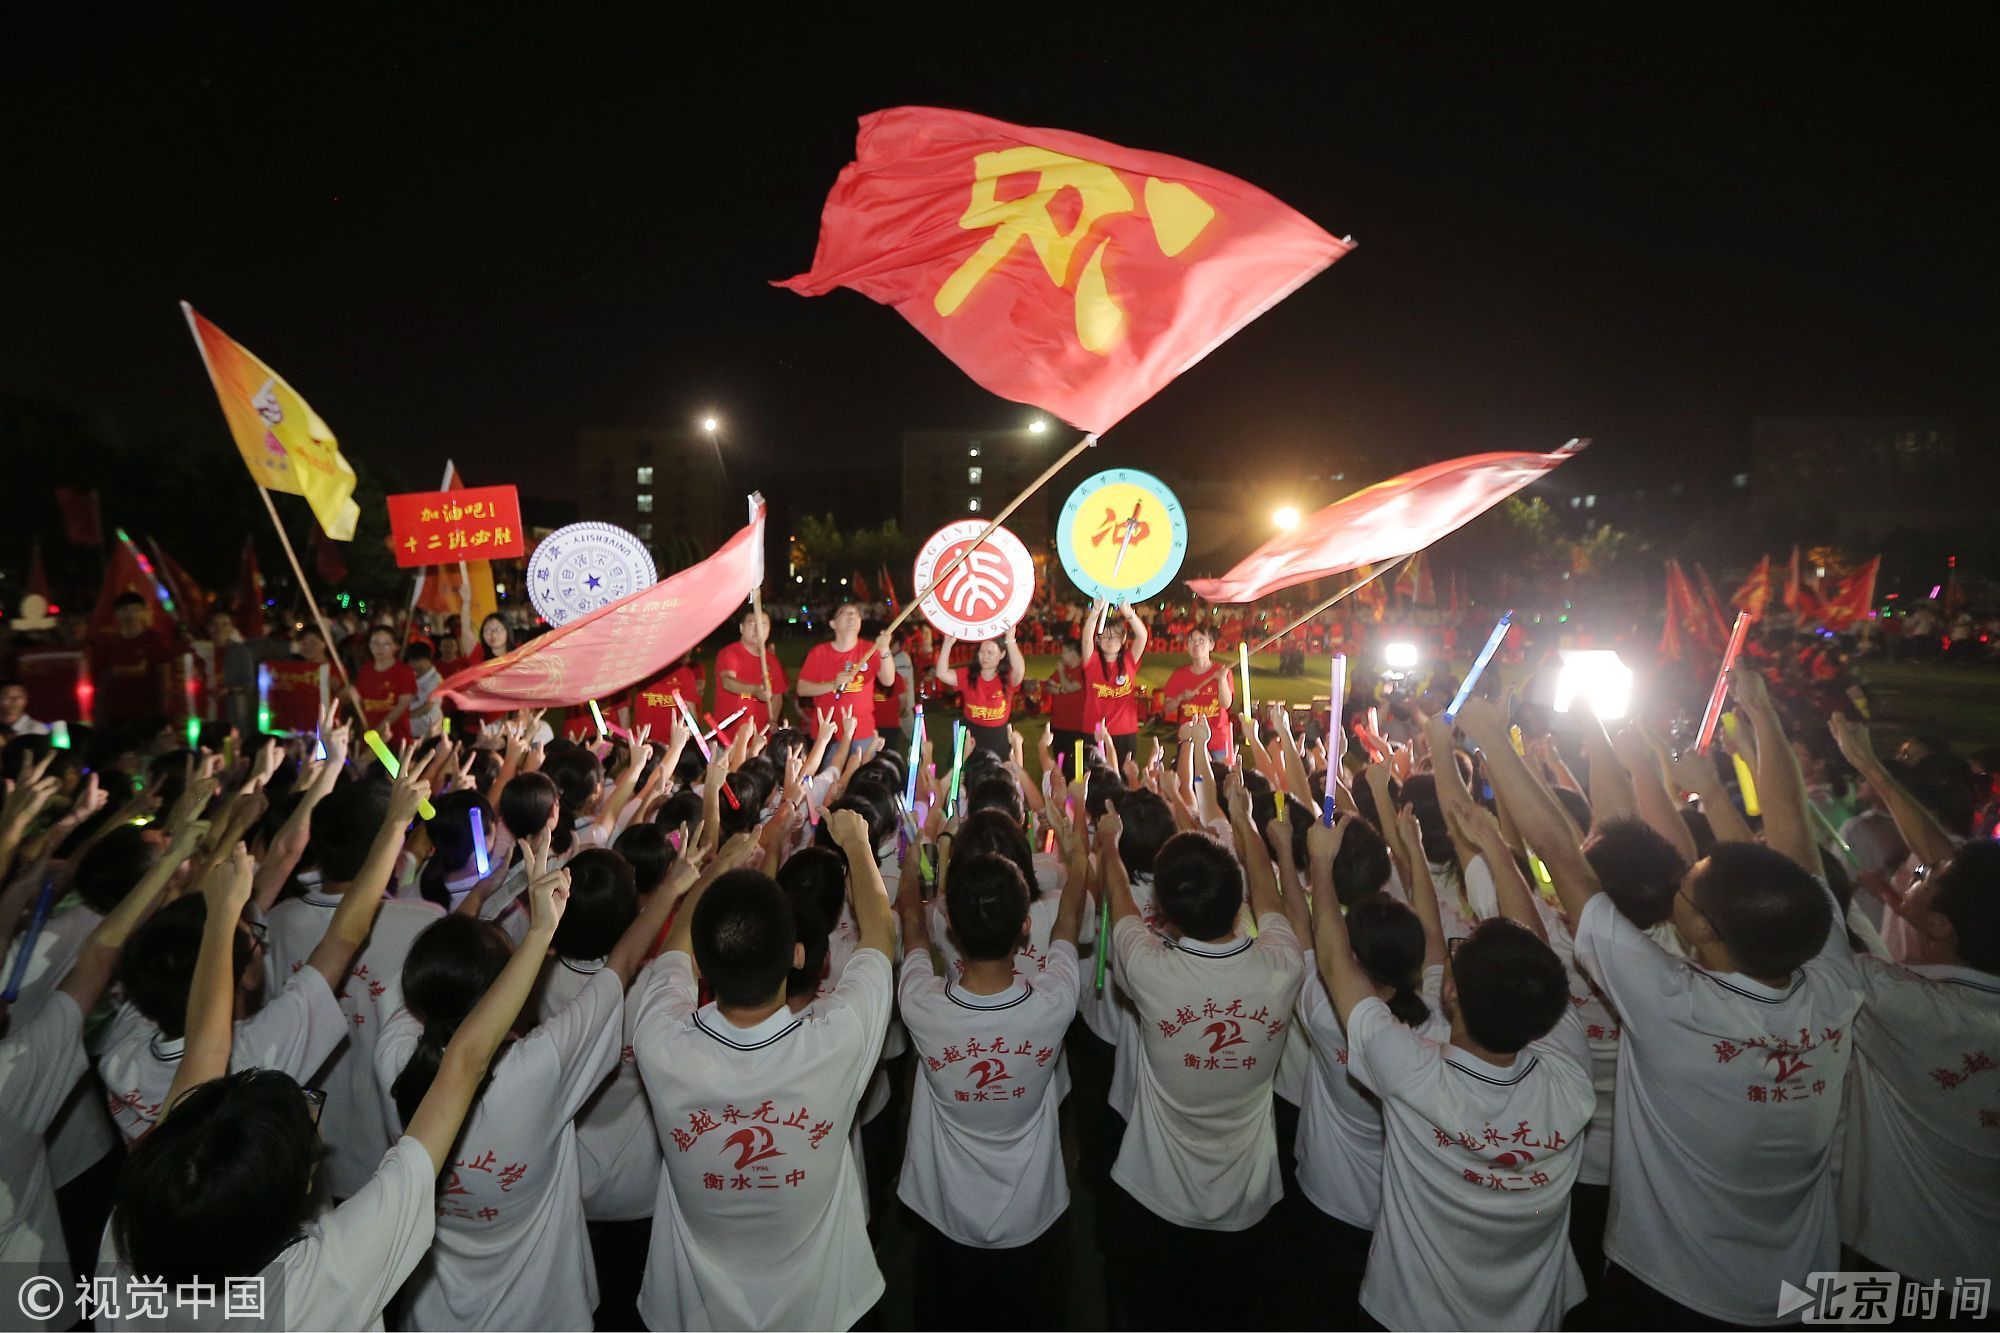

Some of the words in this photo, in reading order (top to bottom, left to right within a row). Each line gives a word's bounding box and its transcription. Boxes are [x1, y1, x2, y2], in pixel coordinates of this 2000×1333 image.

[404, 526, 513, 554] 十二班必胜
[573, 534, 632, 557] UNIVERSITY
[1184, 1053, 1257, 1071] 衡水二中
[953, 1086, 1026, 1103] 衡水二中
[1747, 1079, 1826, 1104] 衡水二中
[702, 1168, 806, 1191] 衡水二中
[1462, 1168, 1550, 1191] 衡水二中
